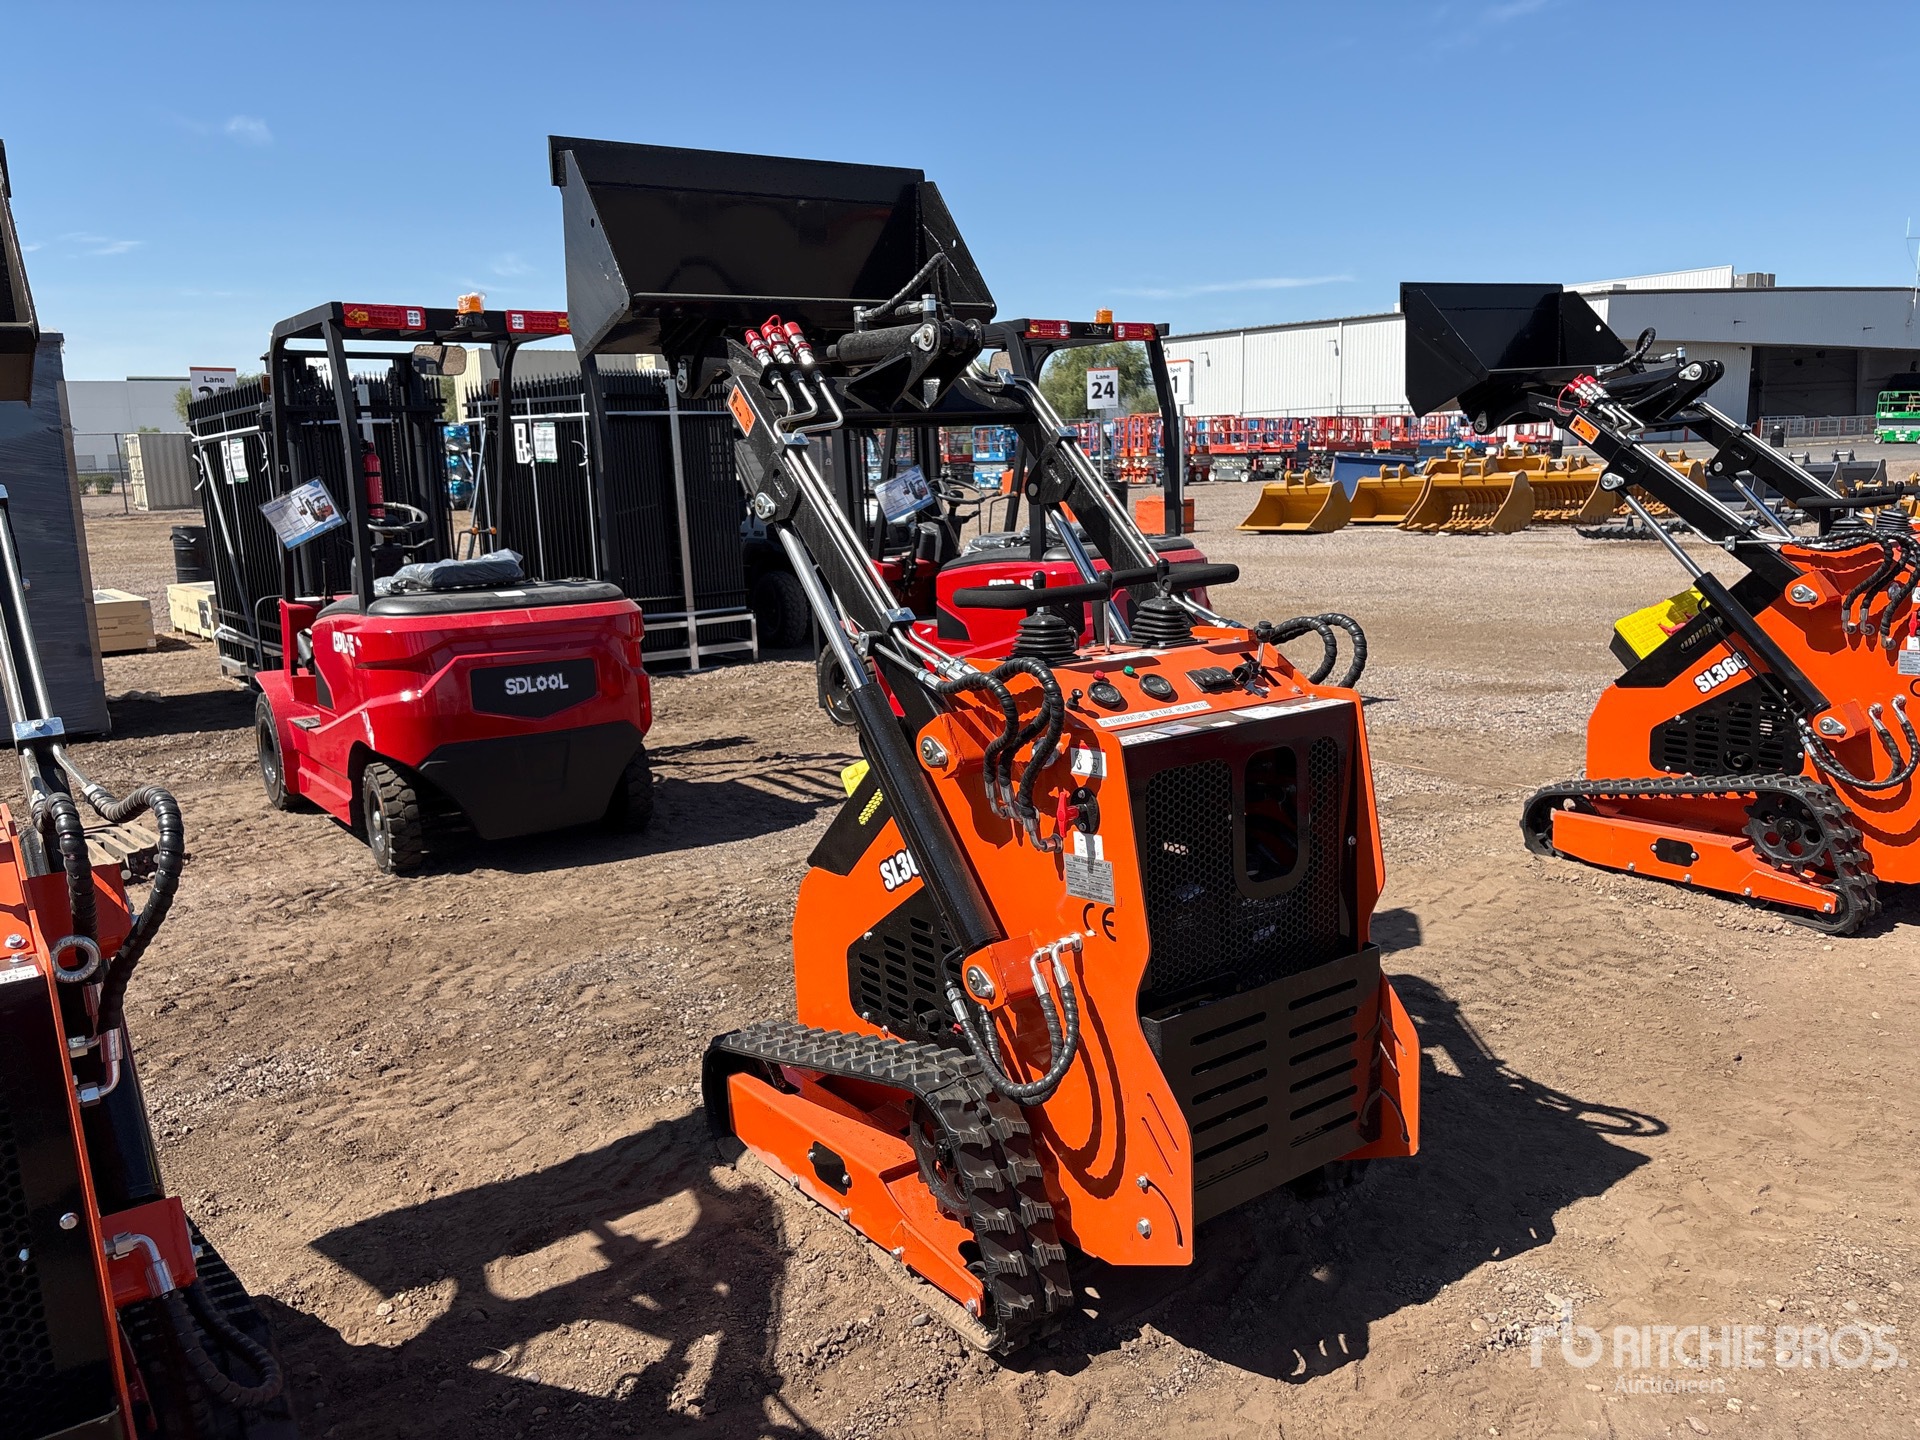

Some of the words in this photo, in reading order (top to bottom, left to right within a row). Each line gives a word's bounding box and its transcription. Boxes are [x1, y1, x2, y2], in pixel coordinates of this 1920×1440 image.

[203, 375, 225, 383] Lane
[1091, 381, 1115, 399] 24
[505, 673, 569, 695] SDLOOL
[1150, 707, 1174, 718] VOLTAGE
[1176, 705, 1191, 713] HOUR
[1082, 902, 1117, 942] CE
